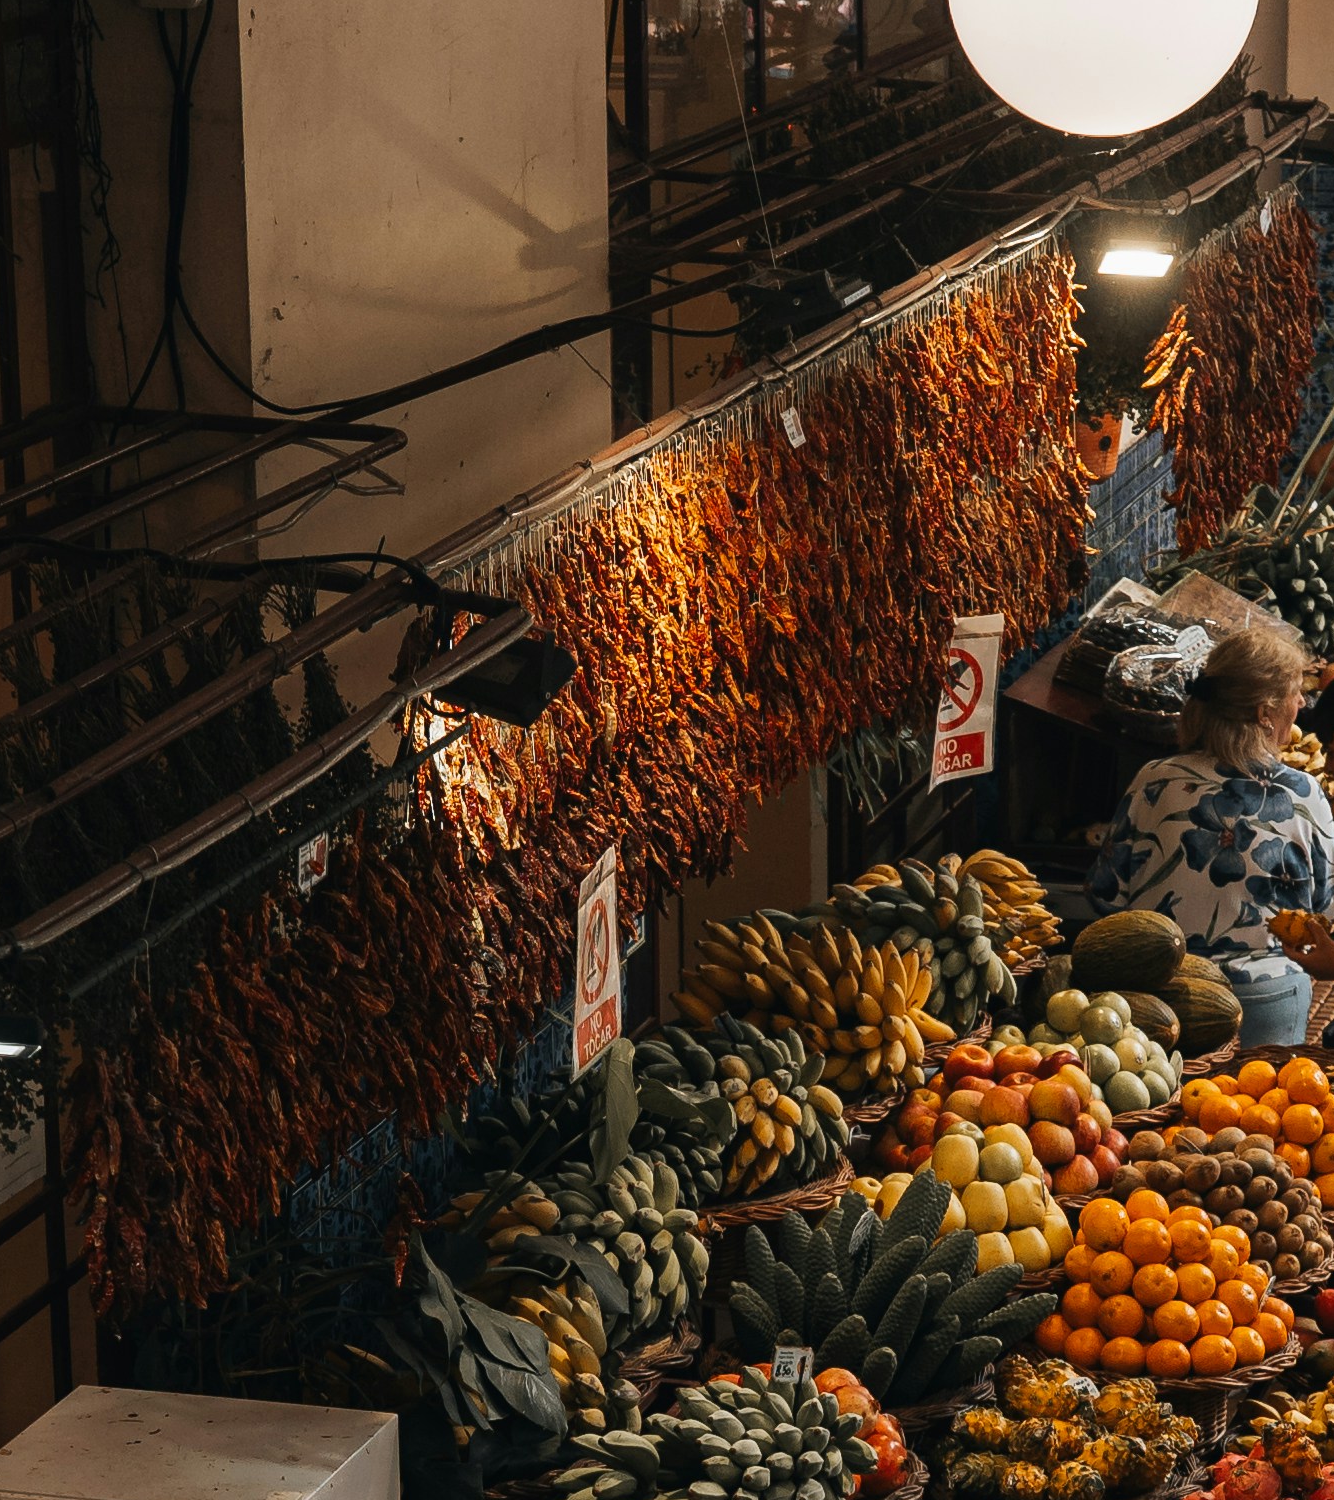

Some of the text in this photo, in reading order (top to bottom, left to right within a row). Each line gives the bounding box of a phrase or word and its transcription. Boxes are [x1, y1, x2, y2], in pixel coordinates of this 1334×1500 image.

[939, 739, 957, 756] NO
[937, 753, 972, 774] OCAR
[590, 1010, 602, 1034] NO
[584, 1024, 612, 1060] TOCAR
